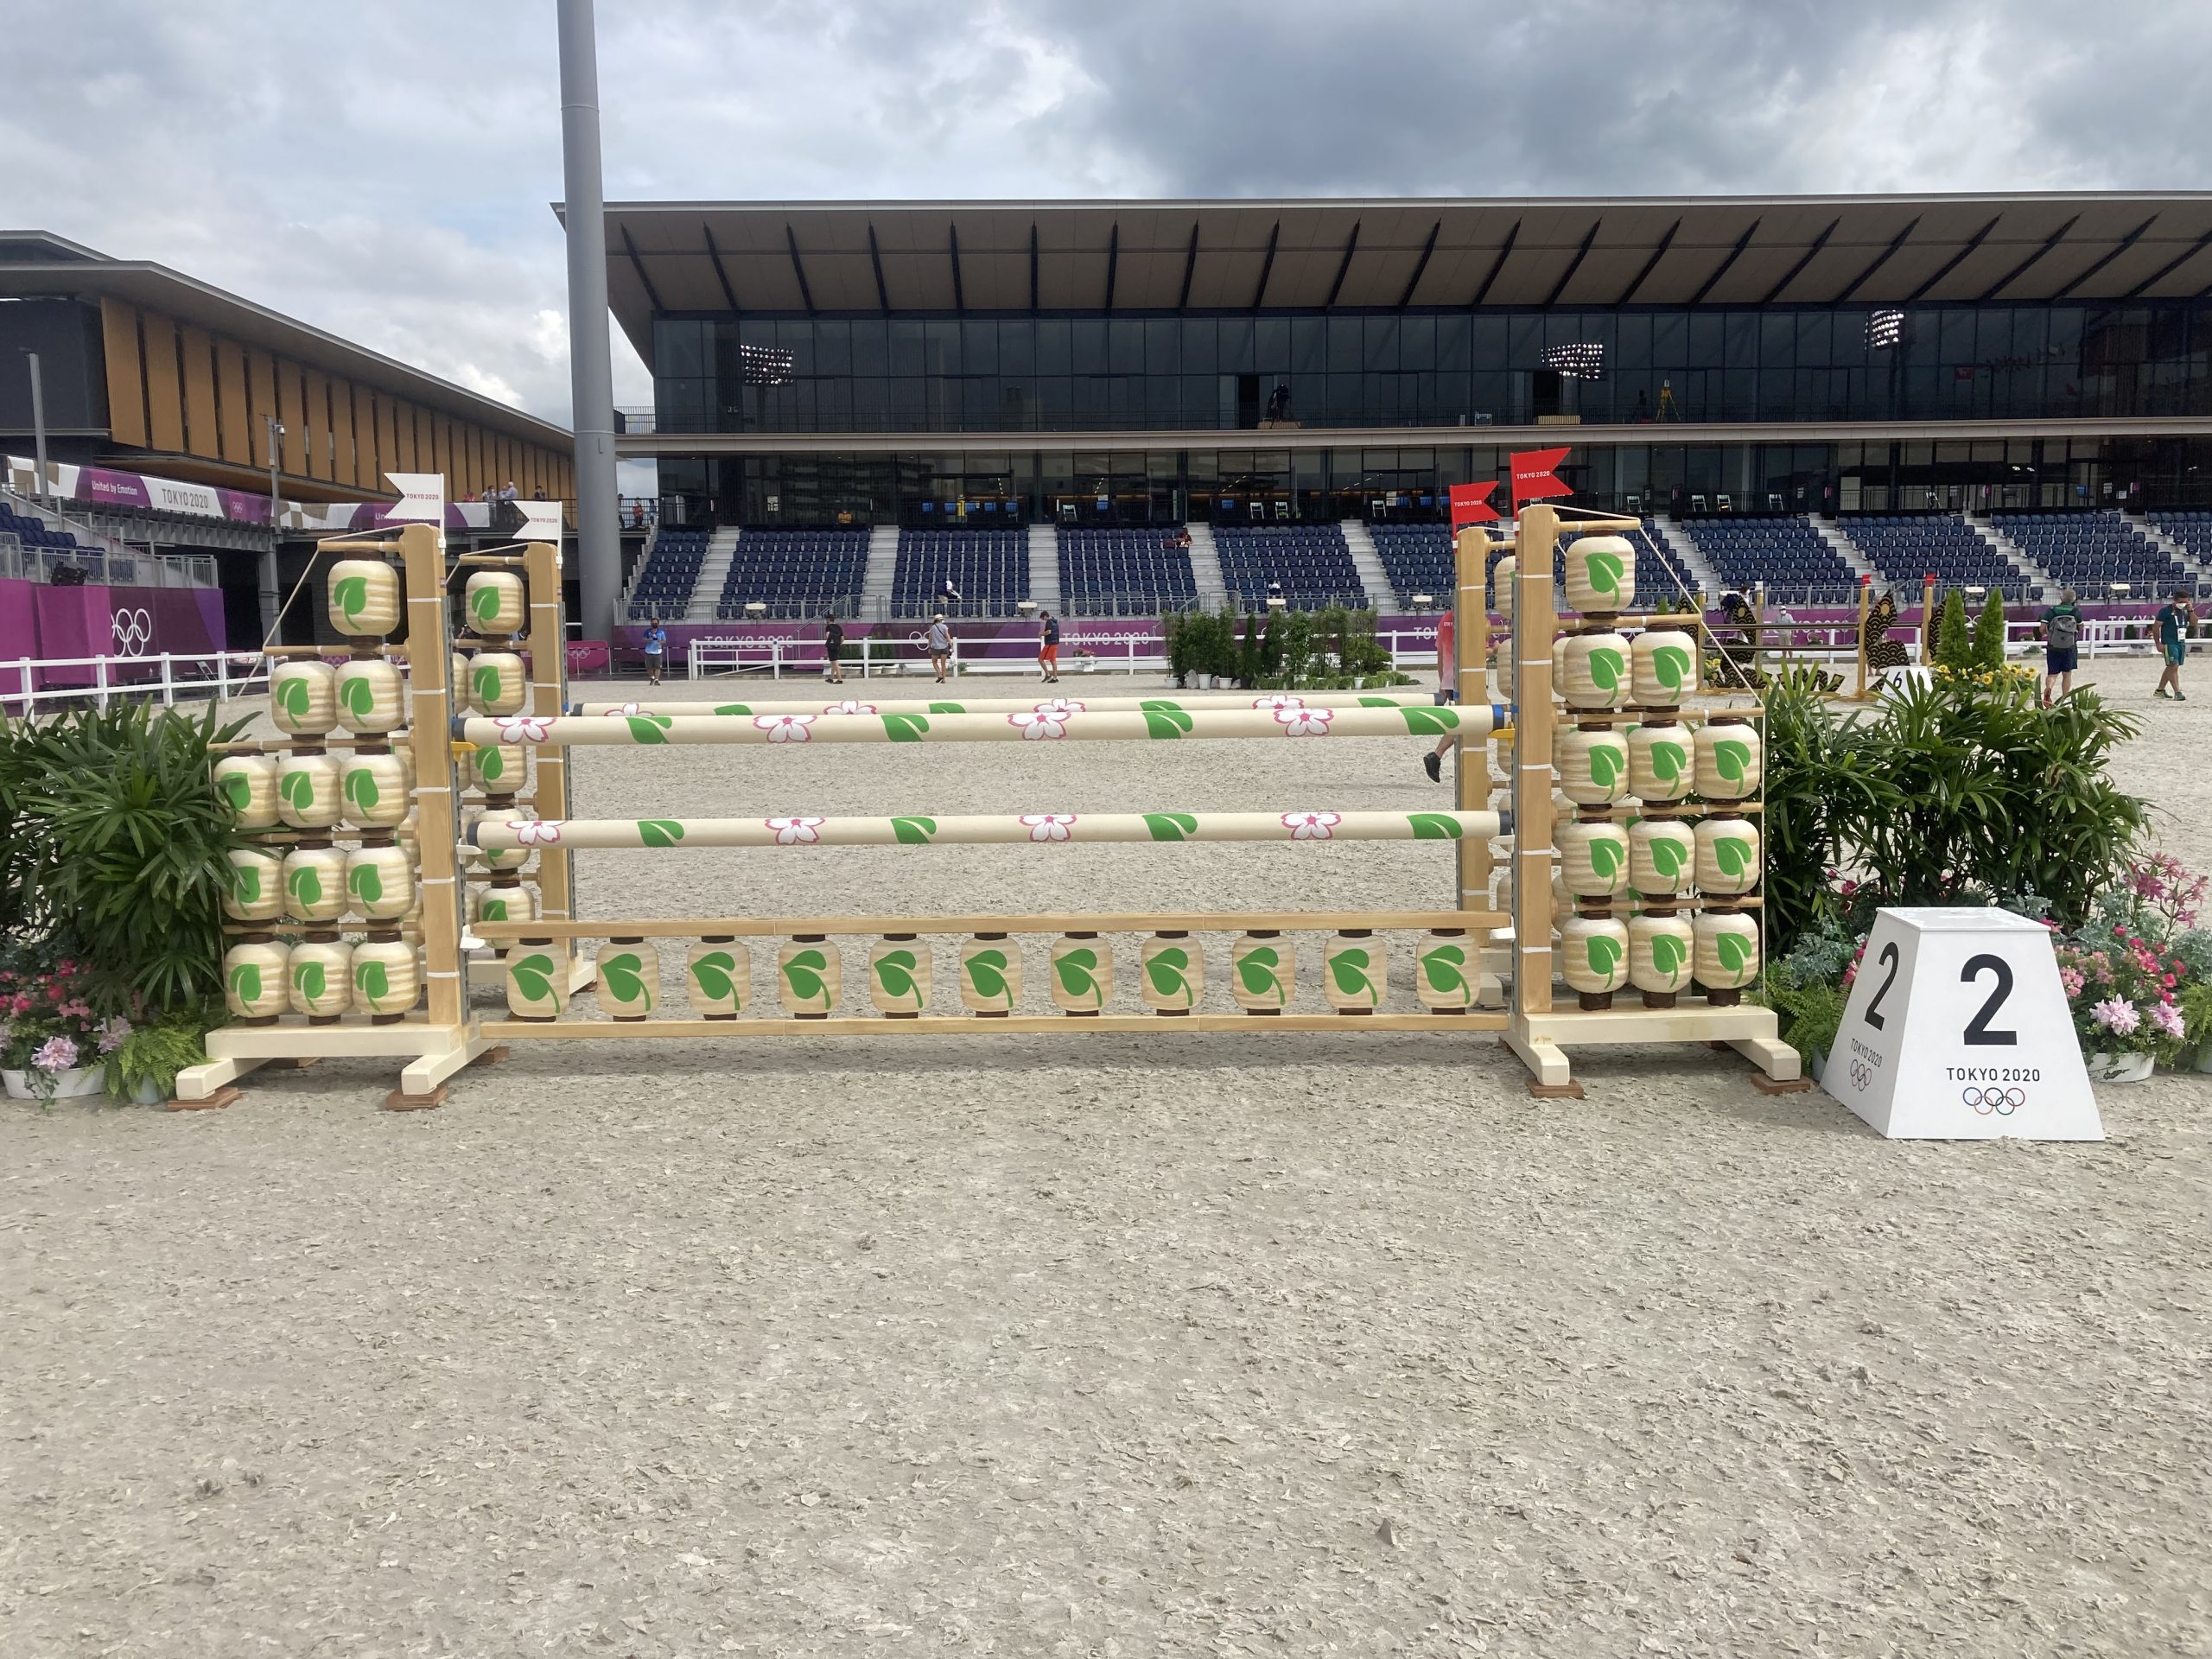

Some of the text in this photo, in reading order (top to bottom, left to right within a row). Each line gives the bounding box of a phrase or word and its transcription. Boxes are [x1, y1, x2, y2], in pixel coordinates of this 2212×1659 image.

[92, 480, 138, 496] United by Emotion
[162, 488, 208, 509] TOKYO 2020
[1063, 632, 1110, 645] TOKYO
[1893, 671, 1902, 689] 6
[1864, 941, 1899, 1031] 2
[1960, 953, 2017, 1046] 2
[1851, 1038, 1883, 1068] TOKYO 2020
[1946, 1067, 2040, 1082] TOKYO 2020
